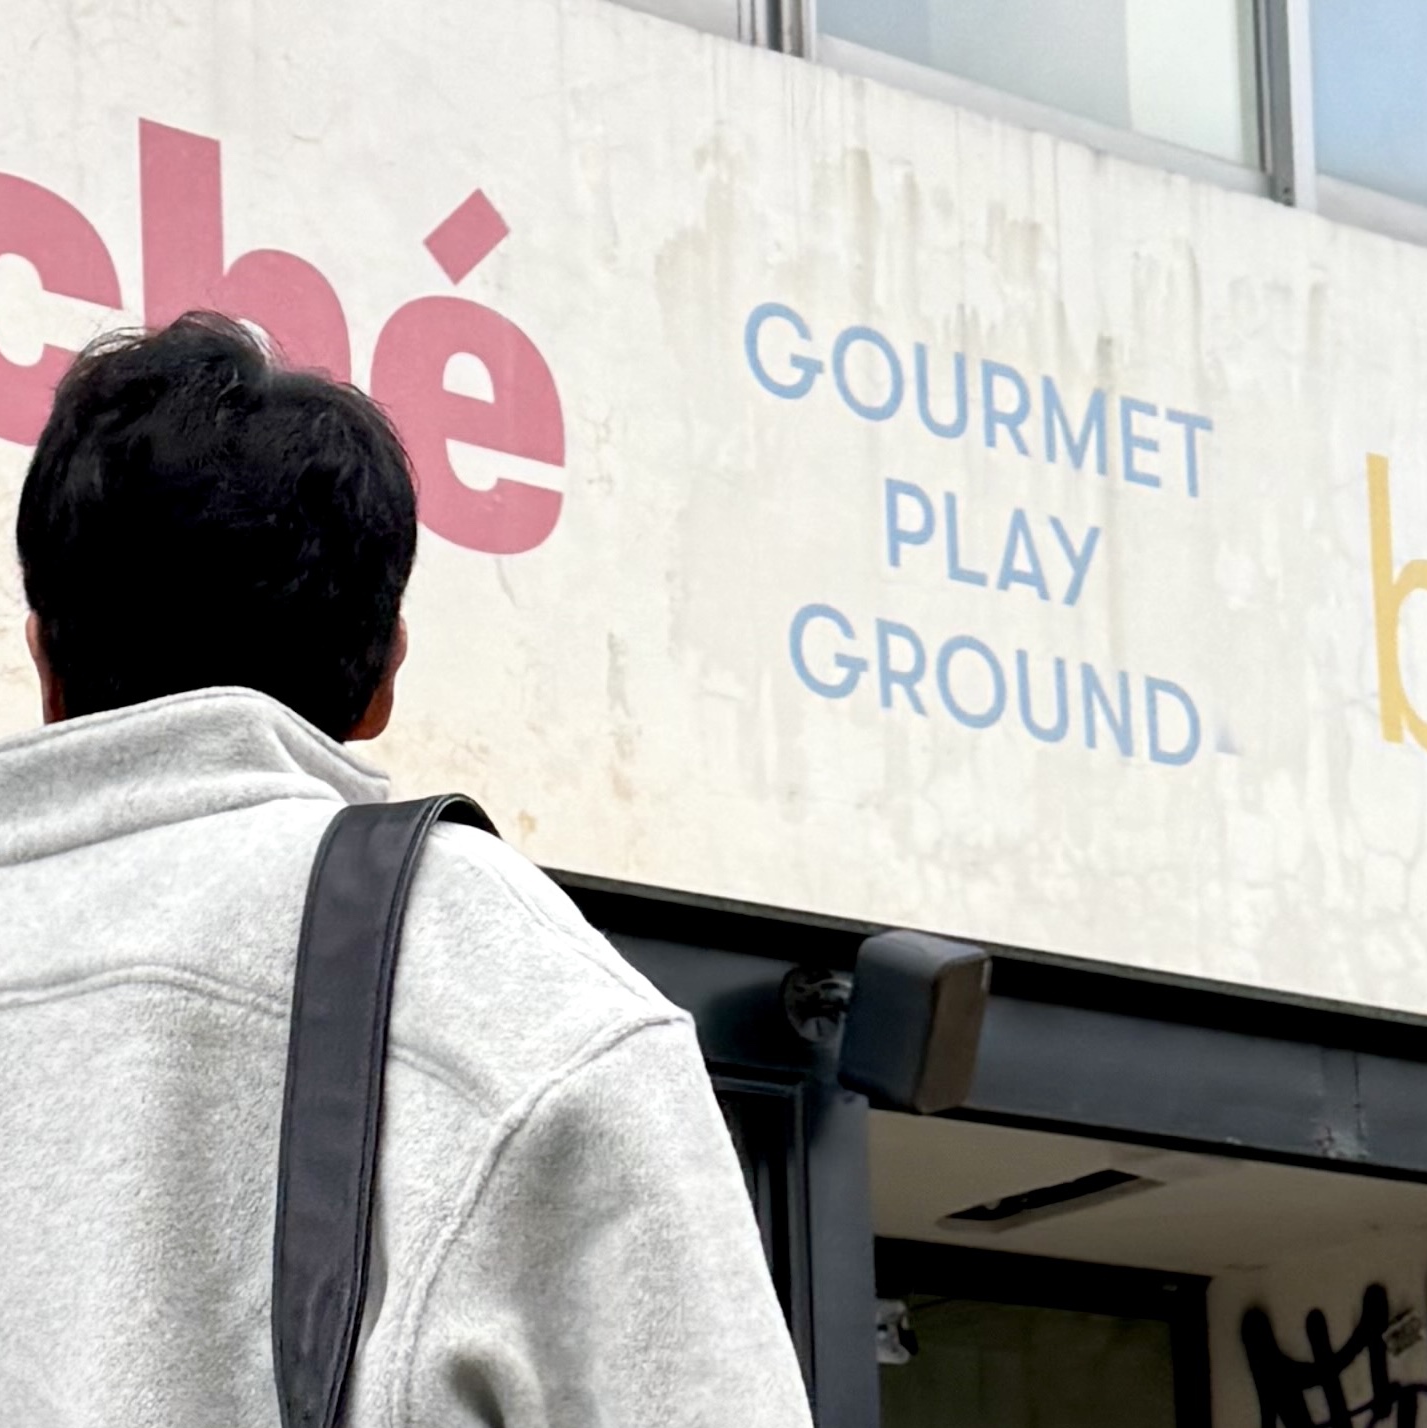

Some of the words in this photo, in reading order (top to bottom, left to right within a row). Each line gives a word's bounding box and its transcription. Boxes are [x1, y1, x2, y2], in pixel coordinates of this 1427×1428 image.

[744, 302, 1213, 498] GOURMET
[884, 477, 1101, 606] PLAY
[788, 602, 1202, 766] GROUND
